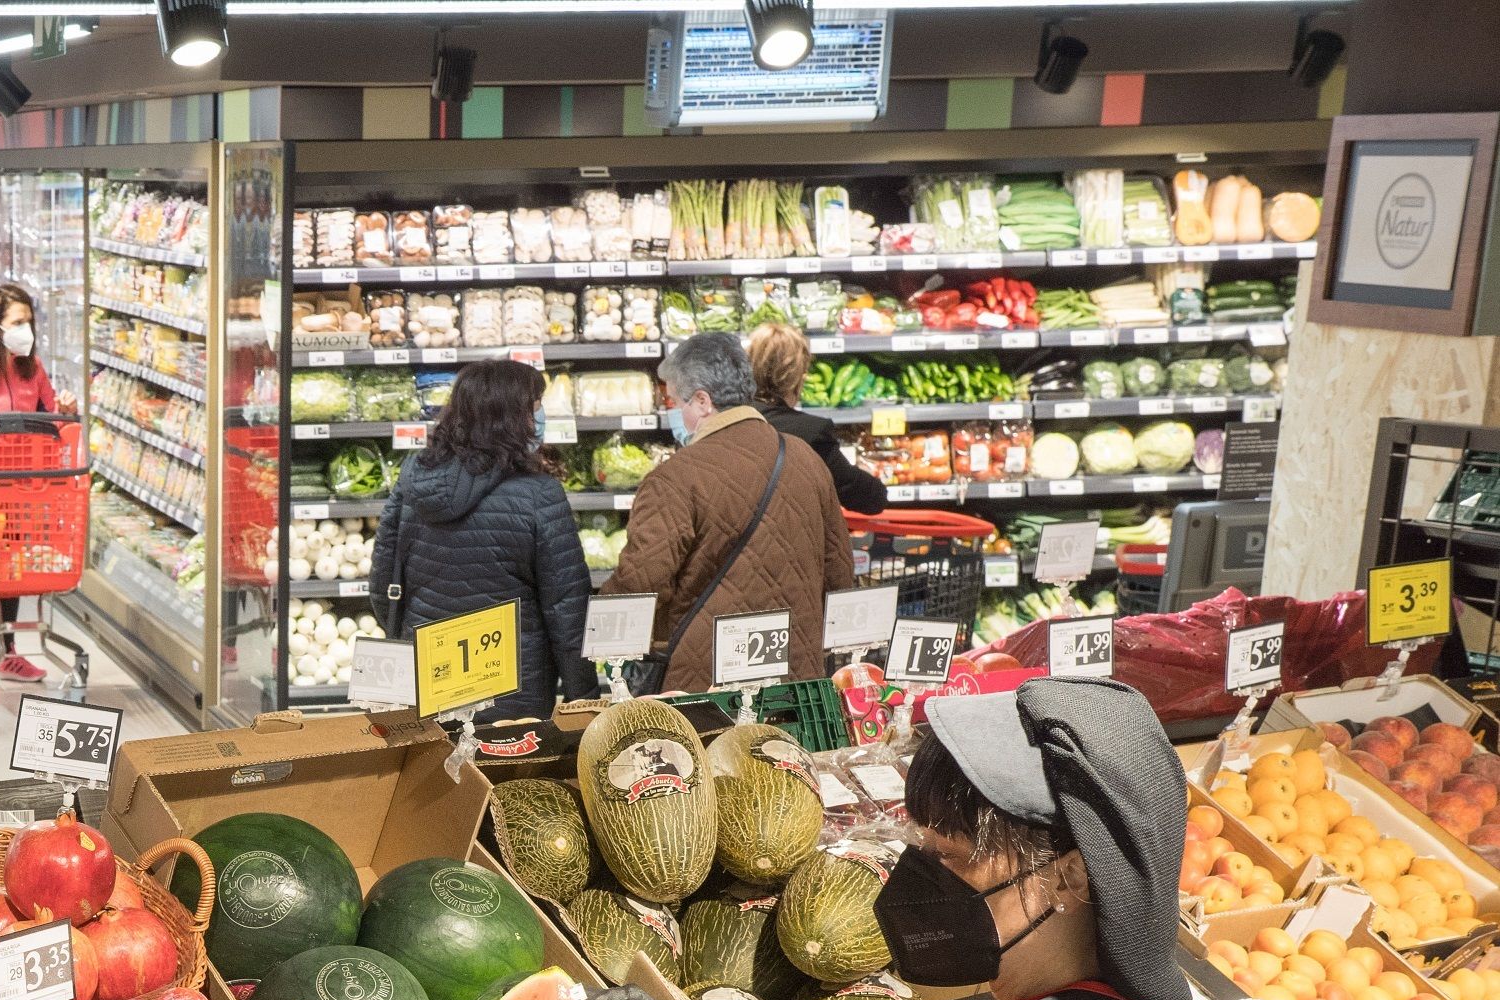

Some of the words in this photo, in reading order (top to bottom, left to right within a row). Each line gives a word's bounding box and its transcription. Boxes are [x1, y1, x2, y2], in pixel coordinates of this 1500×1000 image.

[1380, 209, 1430, 237] Natur
[1399, 581, 1438, 613] 3,39
[457, 630, 502, 673] 1,99
[734, 643, 747, 654] 42
[748, 629, 789, 665] 2,39
[1064, 645, 1074, 655] 28
[1076, 632, 1110, 664] 4,99
[775, 649, 783, 660] €
[908, 637, 951, 672] 1,99
[1098, 650, 1105, 660] €
[1240, 651, 1249, 662] 37
[1250, 636, 1283, 671] 5,99
[485, 659, 501, 670] €/Kg
[936, 657, 944, 668] €
[1269, 656, 1276, 664] €
[38, 729, 54, 741] 35
[54, 722, 112, 757] 5,75
[90, 748, 100, 759] €
[647, 776, 676, 787] Abuelo
[472, 900, 494, 914] SABOR
[24, 943, 71, 991] 3,35
[56, 967, 65, 979] €
[9, 967, 23, 981] 29
